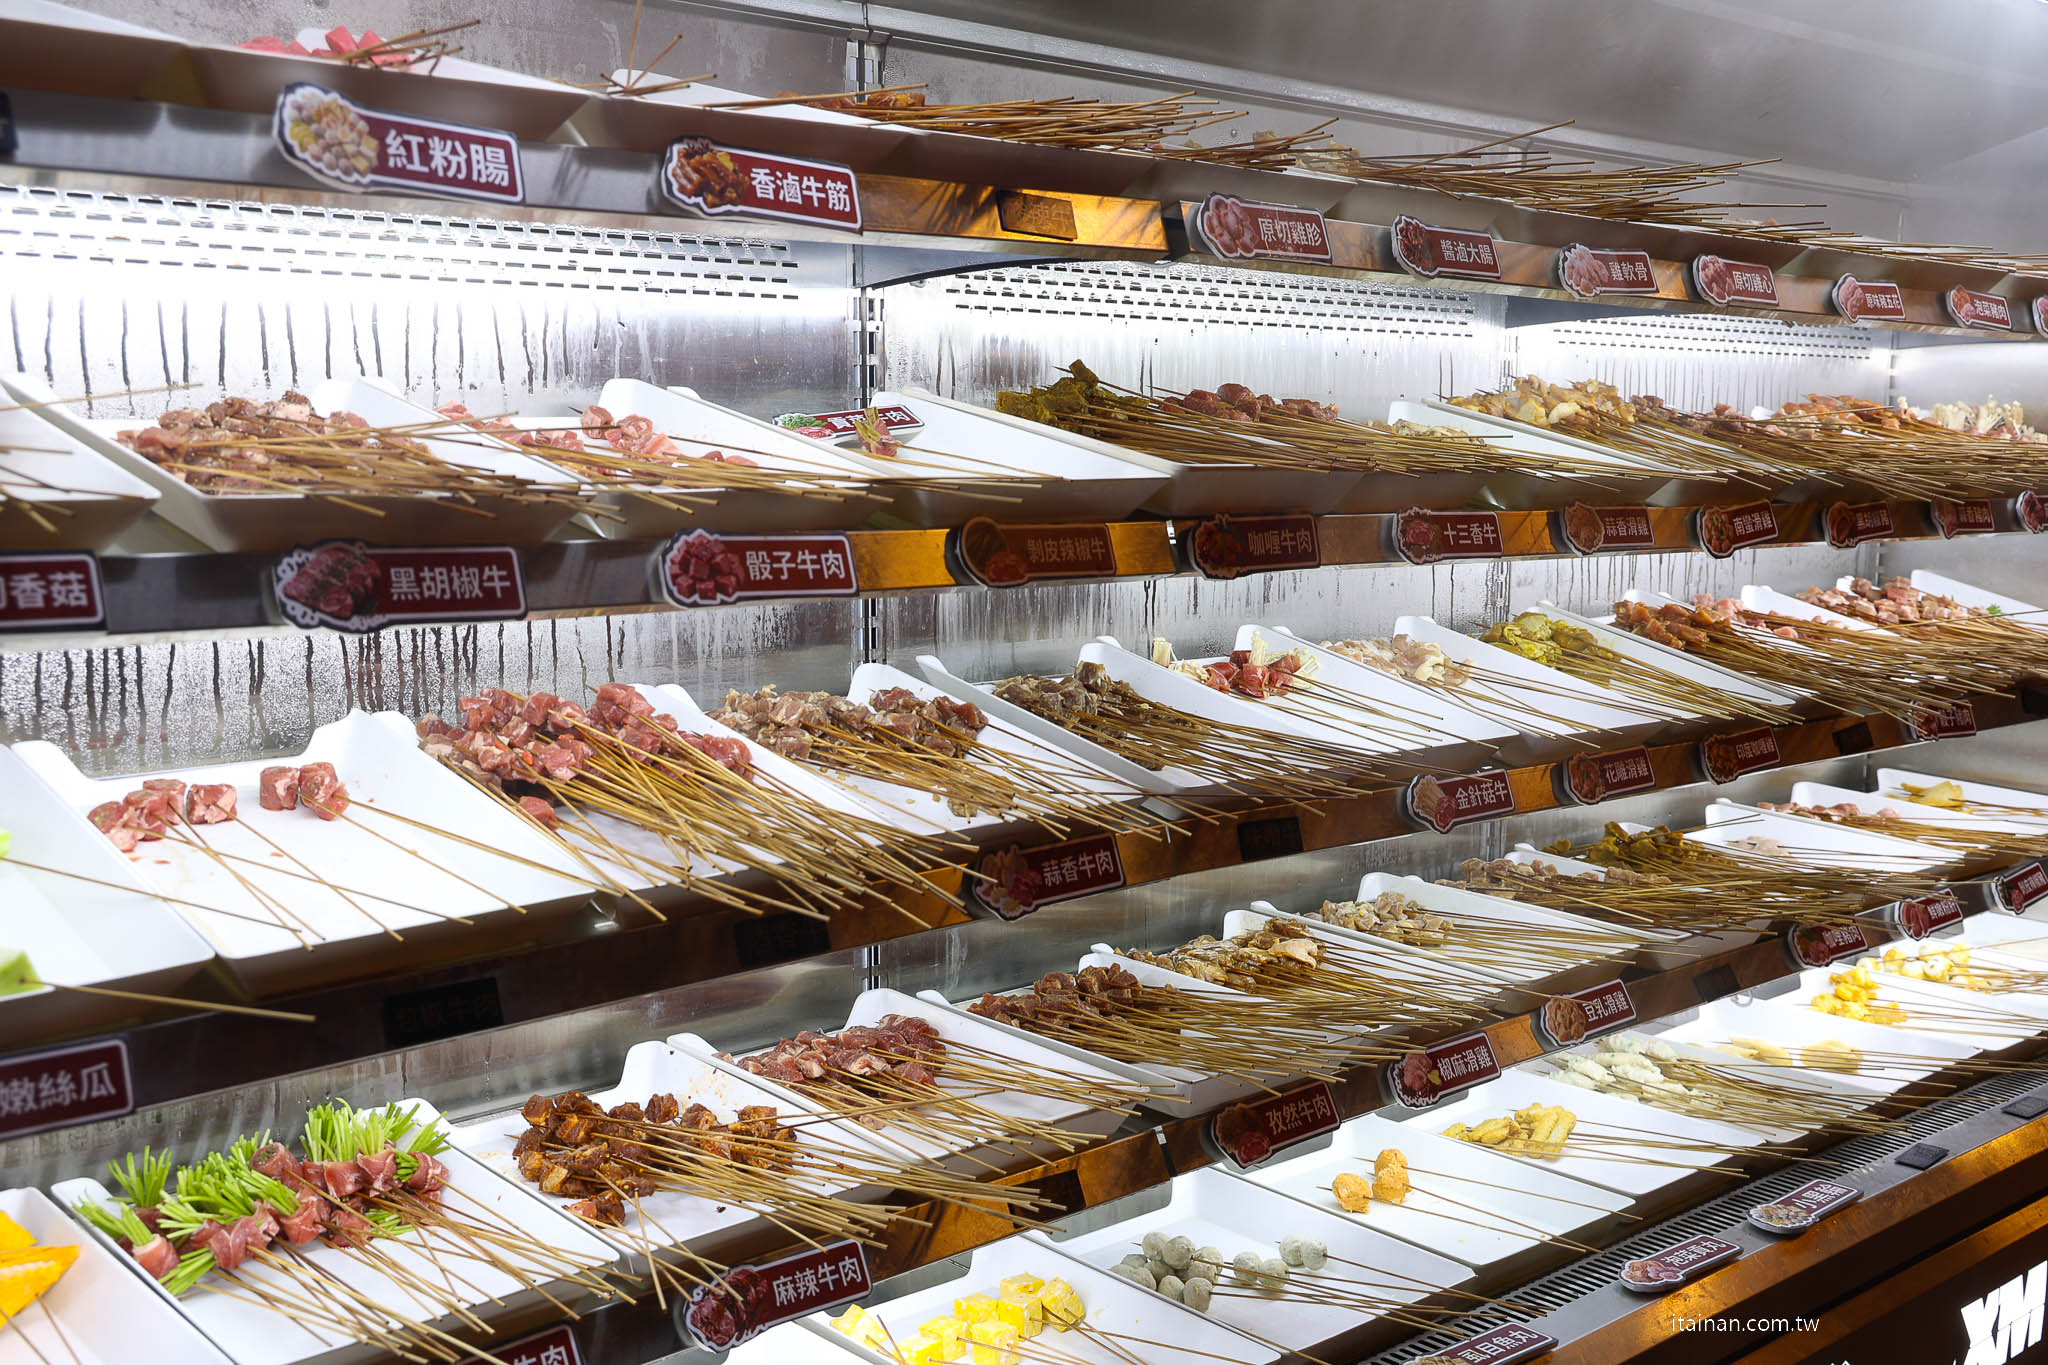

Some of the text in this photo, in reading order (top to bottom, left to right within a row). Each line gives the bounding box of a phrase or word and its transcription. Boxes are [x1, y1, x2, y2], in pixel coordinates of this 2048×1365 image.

[385, 129, 509, 187] 紅粉腸
[751, 168, 850, 213] 香滷牛筋
[1258, 218, 1322, 246] 原切雞胗
[1440, 239, 1494, 265] 醬滷大腸
[1609, 262, 1648, 282] 雞軟骨
[1732, 271, 1773, 294] 原切雞心
[1443, 522, 1497, 545] 十三香牛
[1605, 517, 1649, 536] 蒜香滑雞
[746, 550, 845, 581] 骰子牛肉
[390, 566, 511, 601] 黑胡椒牛
[1456, 781, 1508, 810] 金針菇牛
[1042, 850, 1114, 888] 蒜香牛肉
[1582, 992, 1629, 1022] 豆乳滑雞
[1438, 1045, 1493, 1080] 椒麻滑雞
[1266, 1094, 1331, 1134] 孜然牛肉
[1792, 1185, 1849, 1209] 小黑輪
[1662, 1240, 1724, 1267] 泡菜貢丸
[773, 1255, 863, 1306] 麻辣牛肉
